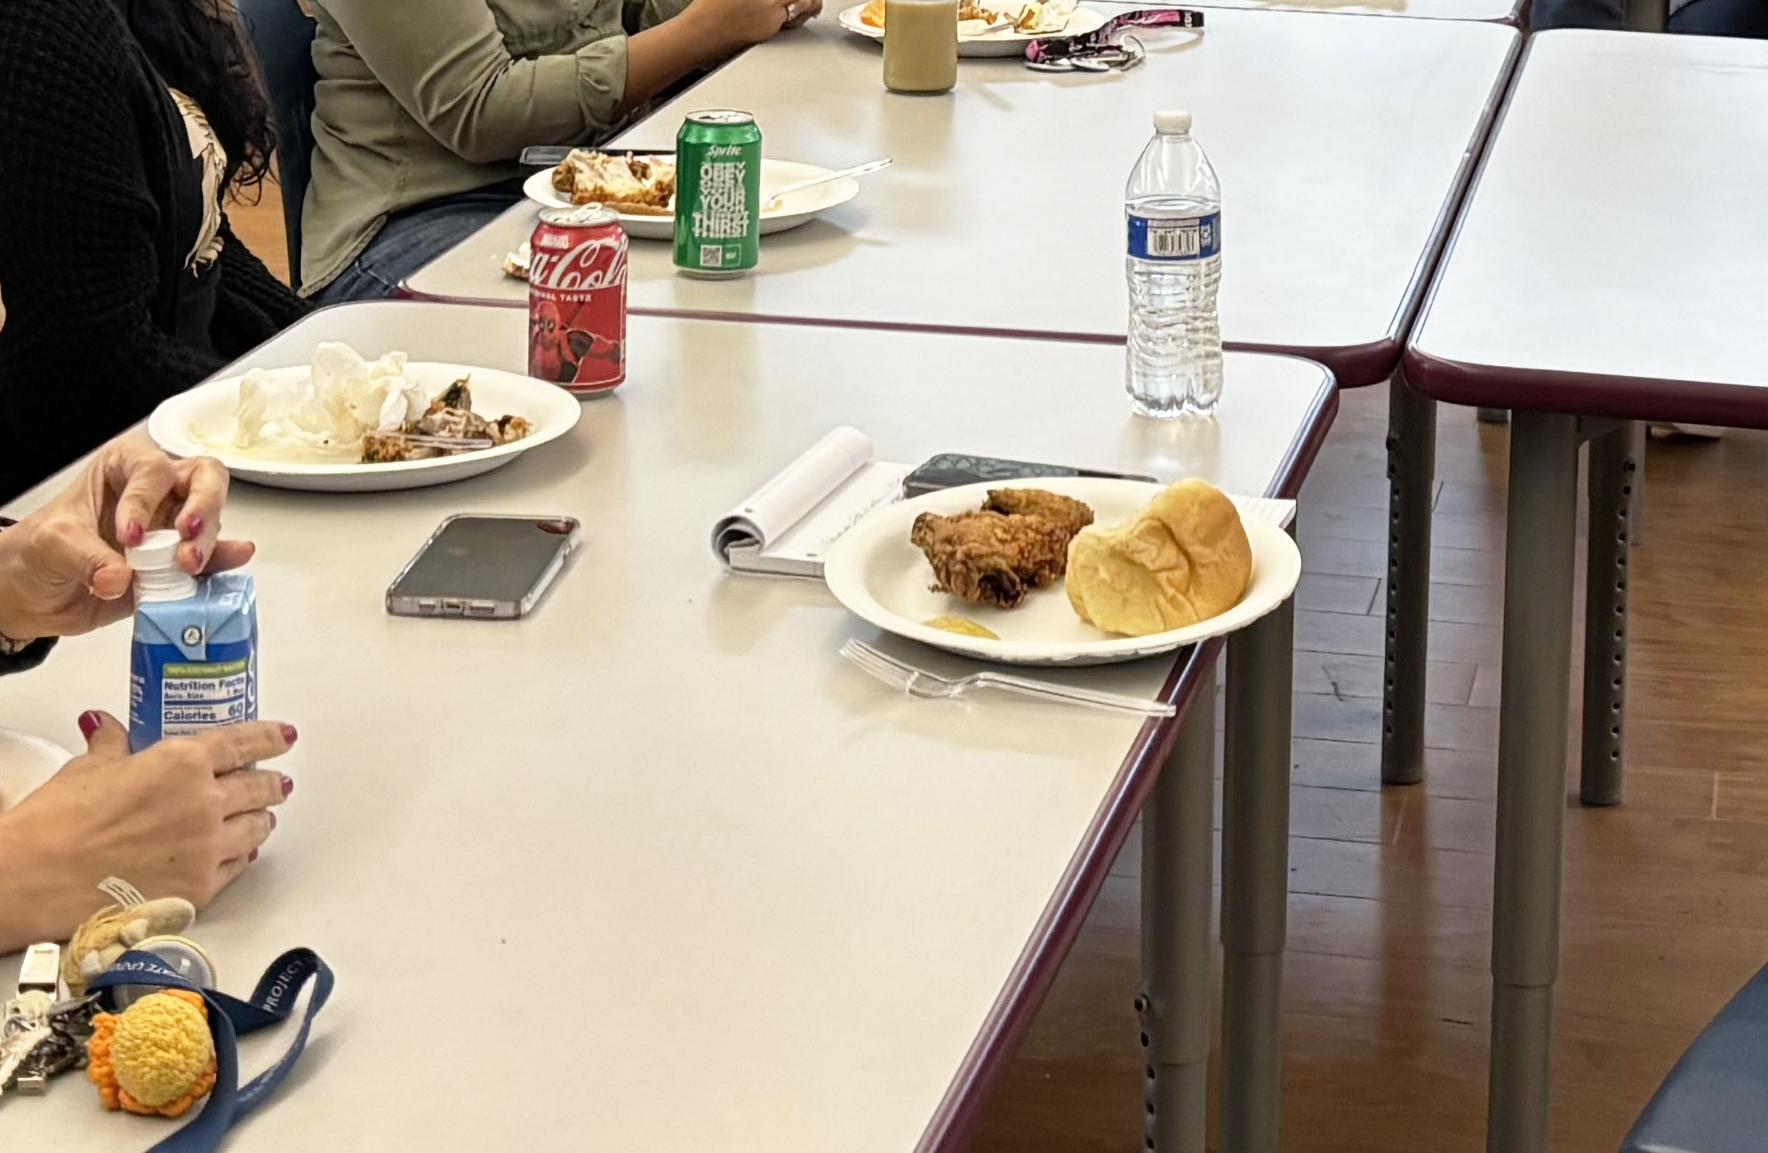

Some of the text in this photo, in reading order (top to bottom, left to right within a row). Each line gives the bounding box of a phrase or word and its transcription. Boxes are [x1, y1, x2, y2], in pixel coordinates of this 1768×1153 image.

[707, 145, 742, 158] Sprite
[700, 165, 746, 183] OBEY
[700, 188, 746, 211] YOUR
[692, 213, 750, 237] THIRST
[164, 677, 244, 690] Nutrition Facts
[164, 703, 243, 720] Calories 60
